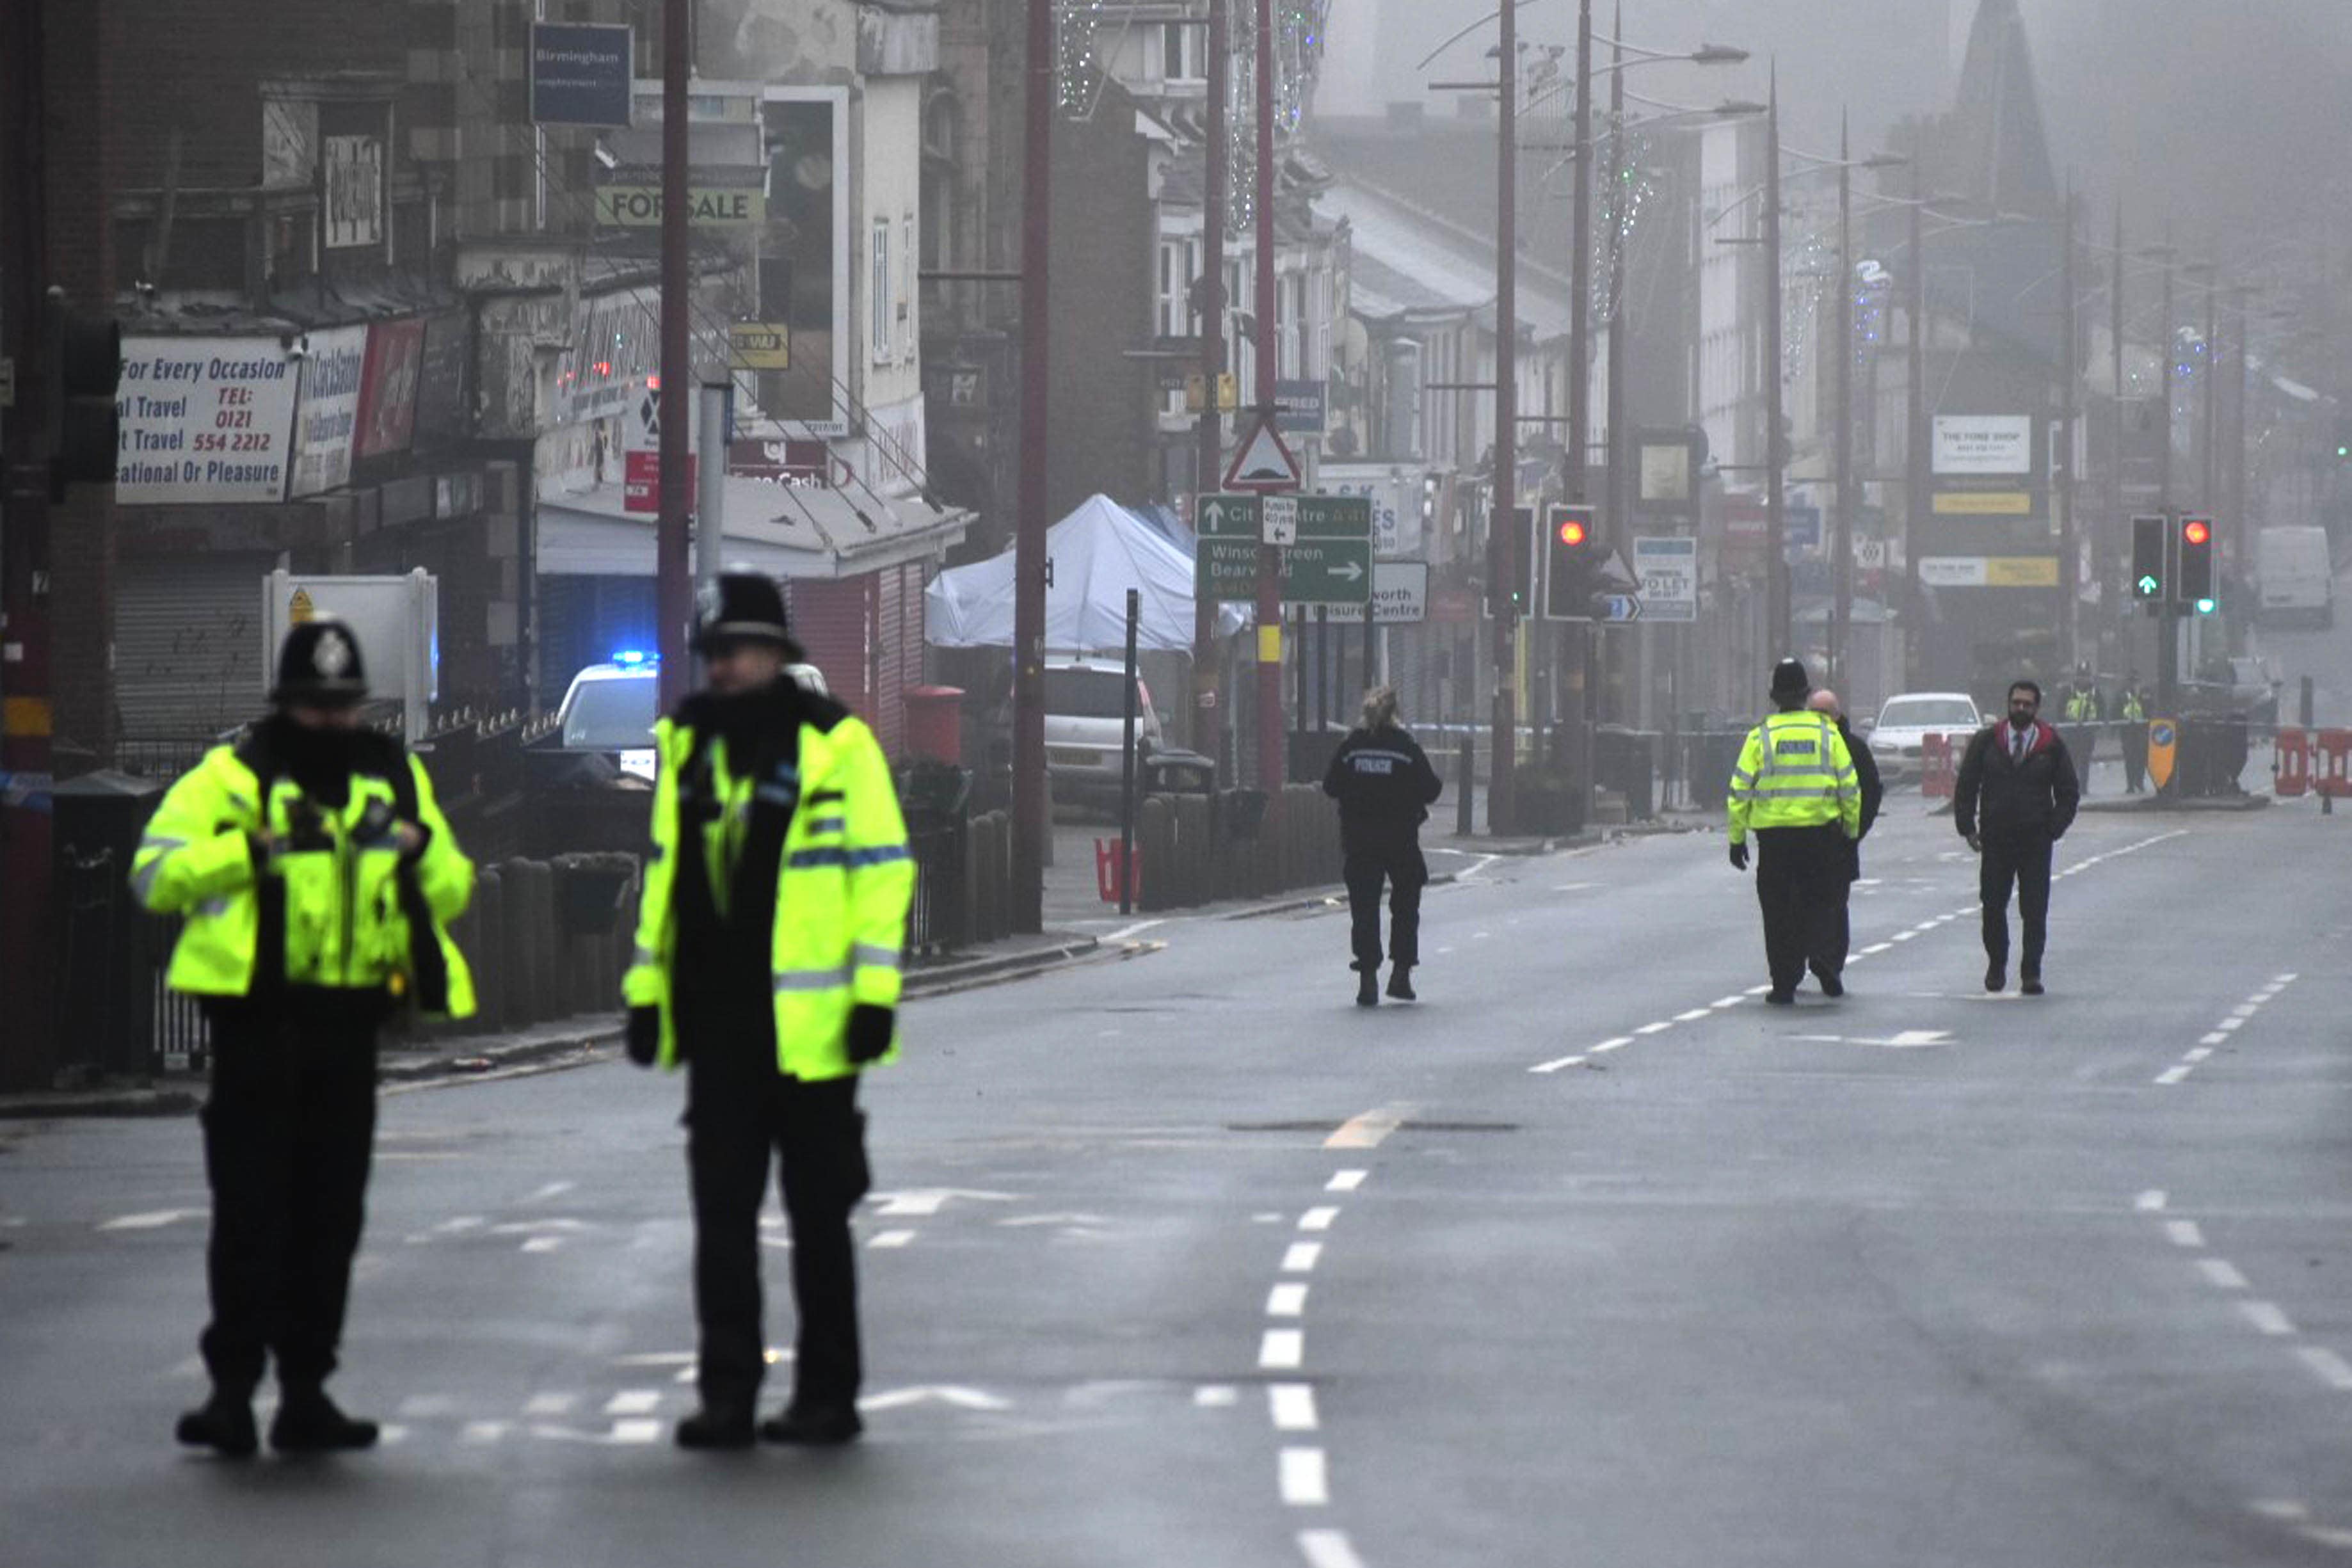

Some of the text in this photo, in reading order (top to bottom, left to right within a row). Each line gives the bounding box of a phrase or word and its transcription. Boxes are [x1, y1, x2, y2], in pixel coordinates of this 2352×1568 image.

[536, 50, 620, 65] Birmingham
[152, 357, 203, 383] Every
[209, 356, 285, 380] Occasion
[218, 387, 253, 406] TEL:
[138, 396, 187, 418] Travel
[215, 410, 252, 428] 0121
[134, 428, 184, 450] Travel
[193, 433, 271, 452] 554 2212
[206, 460, 279, 482] Pleasure
[1230, 506, 1254, 522] Cit
[1297, 506, 1325, 522] tre
[1212, 545, 1256, 559] Wins
[1212, 561, 1293, 578] Beard
[1663, 578, 1690, 589] LET
[1313, 604, 1364, 616] Lisure
